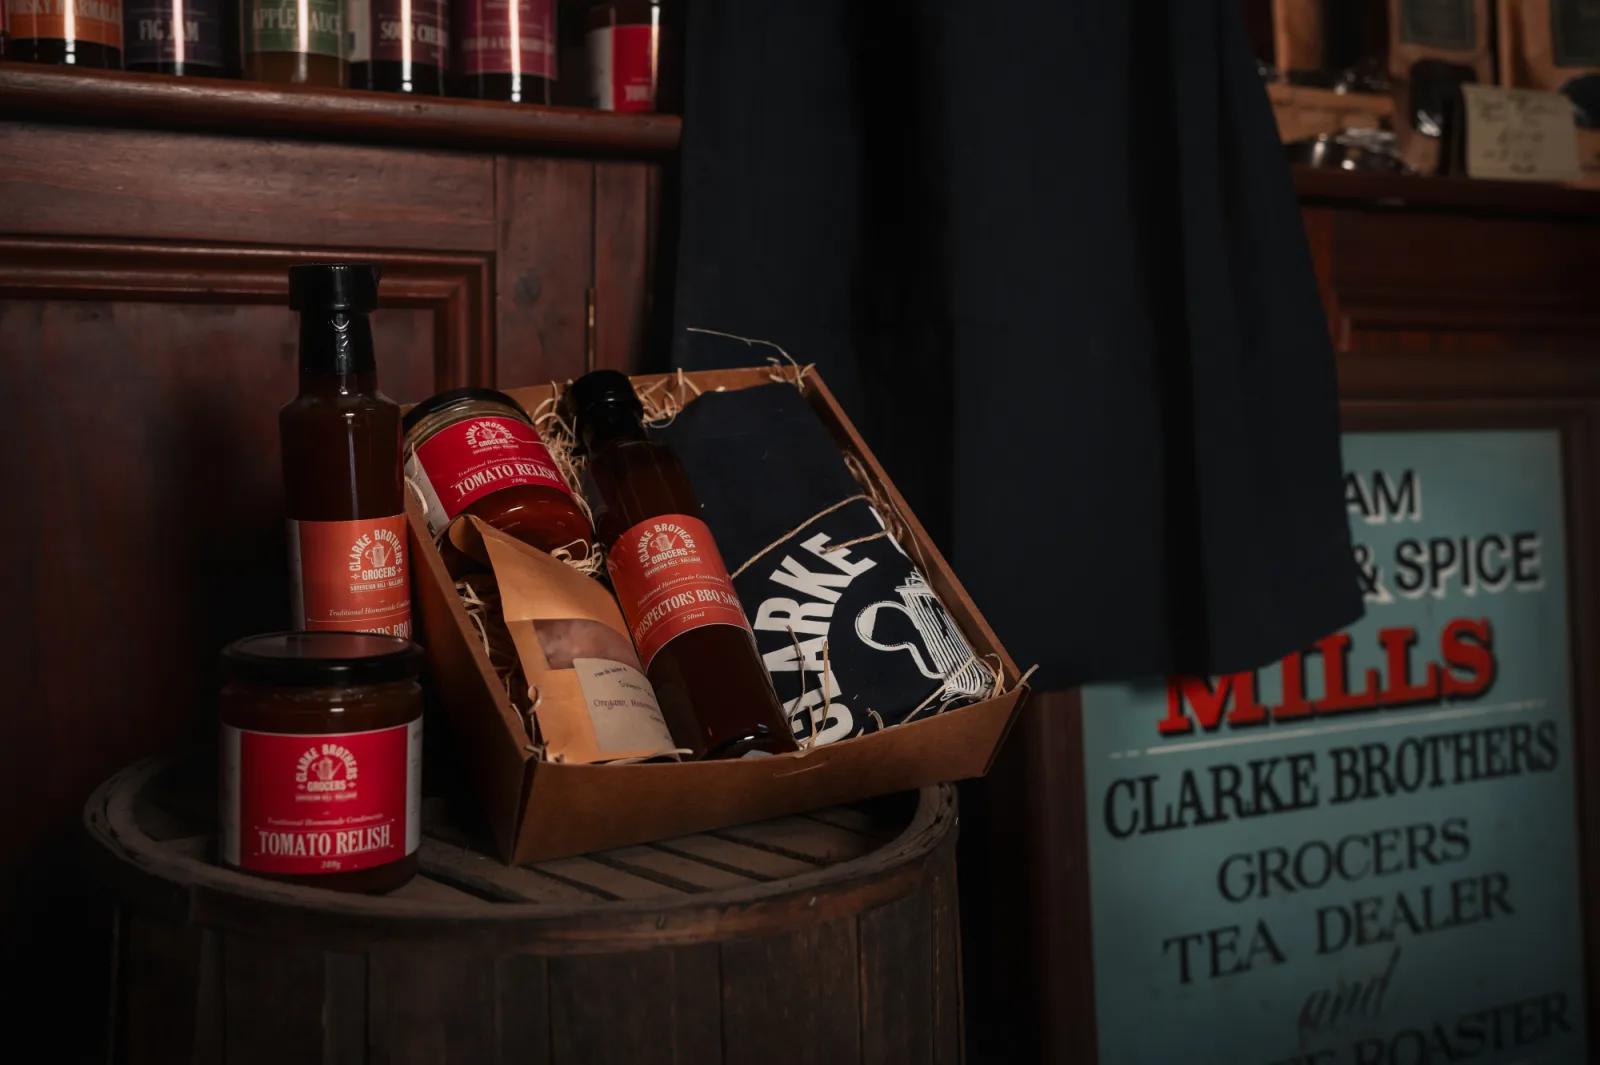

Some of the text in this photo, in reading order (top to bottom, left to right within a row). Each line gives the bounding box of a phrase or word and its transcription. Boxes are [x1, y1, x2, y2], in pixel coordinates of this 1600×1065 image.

[138, 19, 164, 41] FIG
[455, 463, 560, 496] TOMATO RELISH
[1344, 468, 1418, 519] AM
[348, 528, 404, 571] CLARKE BROTHERS
[637, 522, 696, 564] CLARKE BROTHERS
[651, 547, 688, 565] GROCERS
[1396, 531, 1543, 593] SPICE
[361, 566, 397, 581] GROCERS
[328, 607, 364, 617] Traditional
[696, 589, 722, 605] BBQ
[753, 532, 878, 749] CLARKE
[1159, 618, 1498, 738] MILLS
[295, 743, 359, 783] CLARKE BROTHERS
[1103, 721, 1559, 840] CLARKE BROTHERS
[306, 780, 348, 792] GROCERS
[258, 824, 391, 857] TOMATO RELISH
[1217, 817, 1473, 903] GROCERS
[1162, 872, 1515, 986] TEA DEALER
[1296, 946, 1403, 1034] and
[1355, 990, 1572, 1065] ROASTER
